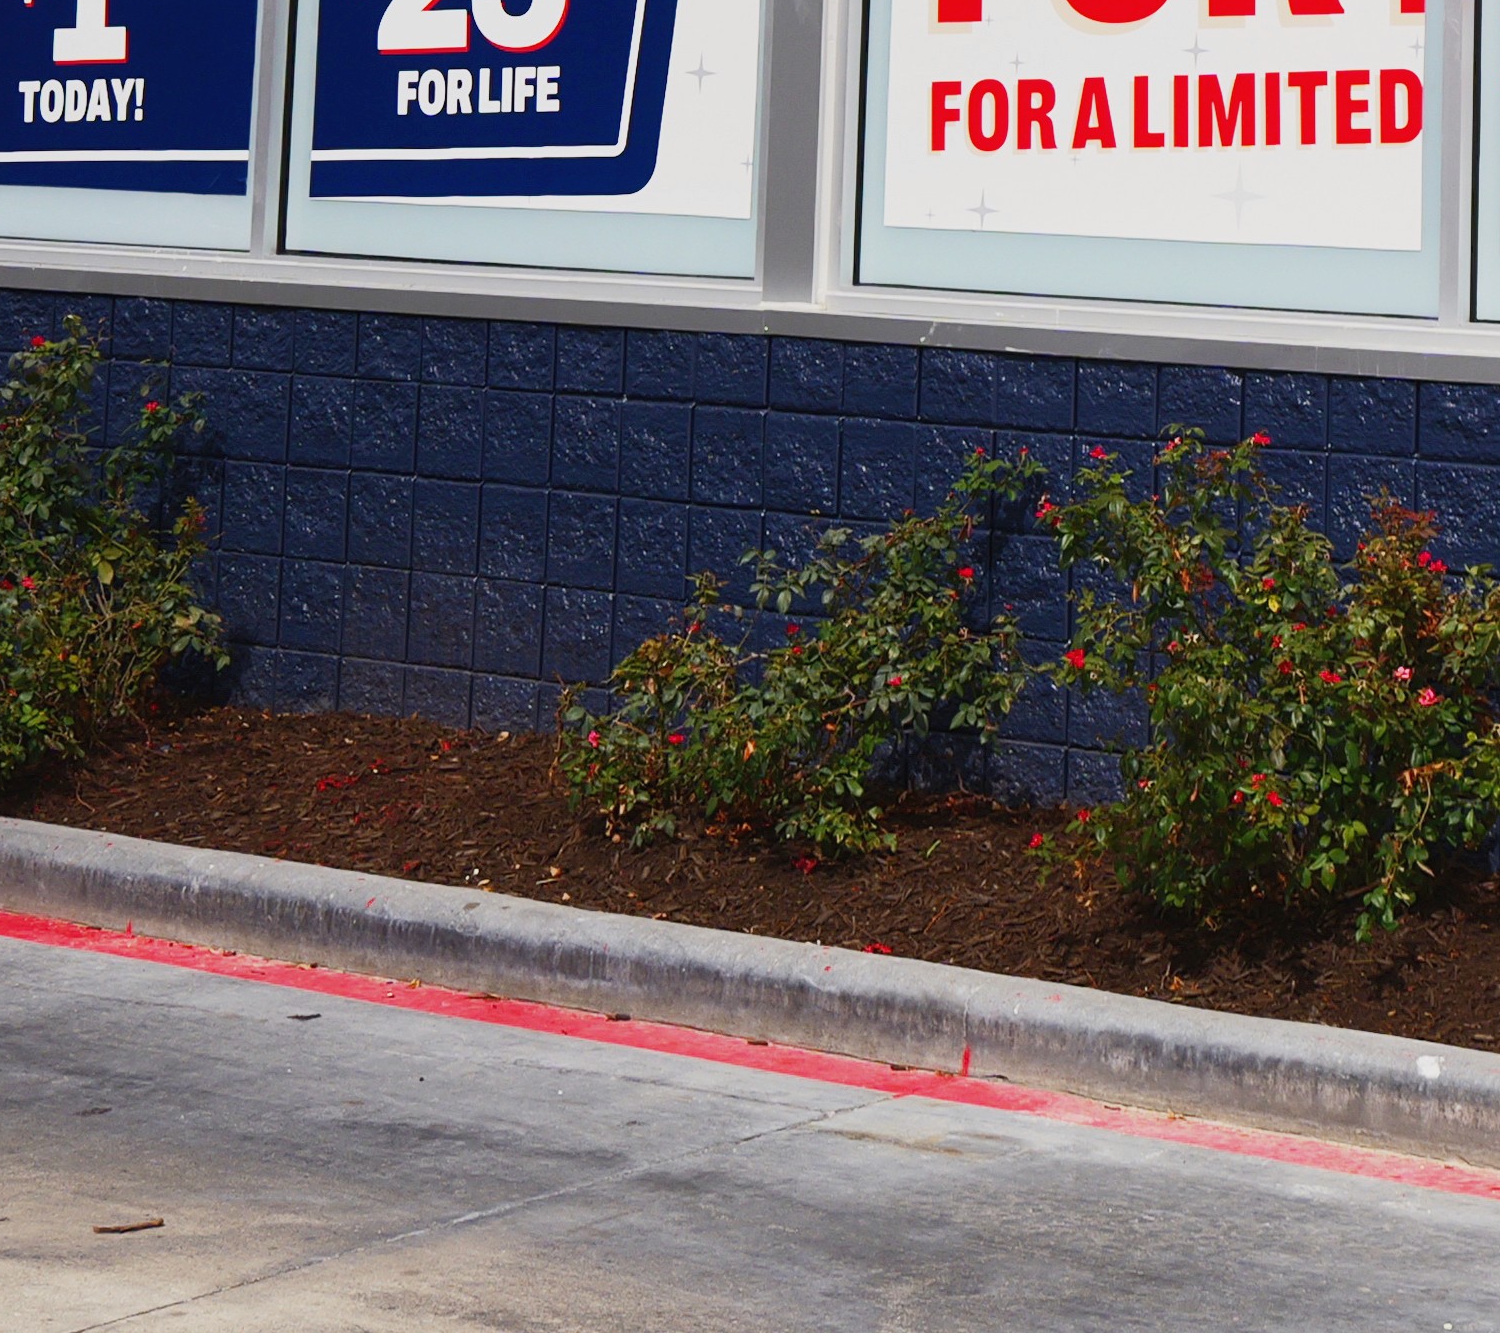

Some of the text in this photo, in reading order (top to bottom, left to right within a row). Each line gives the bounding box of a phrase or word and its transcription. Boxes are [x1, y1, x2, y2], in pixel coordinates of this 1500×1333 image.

[19, 78, 145, 123] TODAY!
[398, 66, 561, 116] FOR LIFE
[931, 78, 1057, 152] FOR
[1071, 76, 1117, 149] A
[1133, 69, 1423, 148] LIMITED
